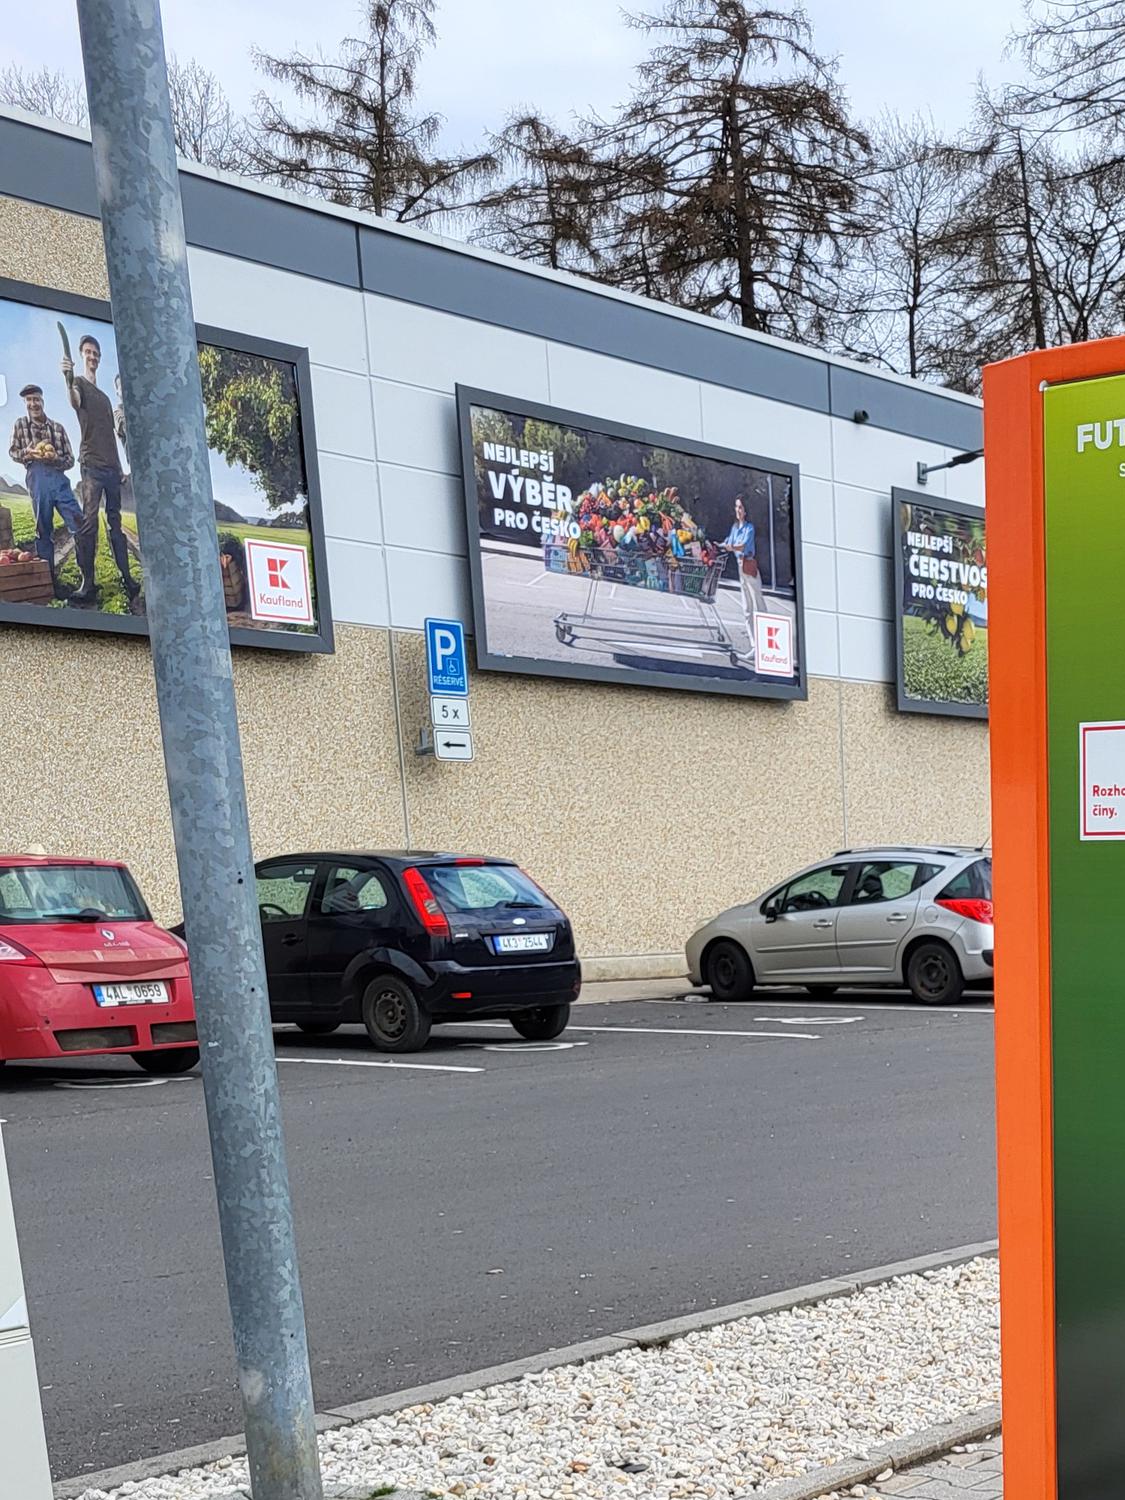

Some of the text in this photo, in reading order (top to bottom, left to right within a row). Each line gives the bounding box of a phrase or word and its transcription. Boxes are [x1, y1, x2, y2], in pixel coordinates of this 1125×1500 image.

[483, 441, 555, 474] NEJLEPŠÍ
[487, 468, 573, 514] VÝBĚR
[494, 508, 581, 539] PRO ČESKO
[907, 531, 953, 554] NEJLEPŠÍ
[909, 548, 987, 589] ČERSTVOS
[259, 593, 304, 608] Kaufland
[911, 582, 969, 605] PRO ČESKO
[434, 628, 457, 671] P
[442, 705, 449, 719] 5
[1092, 804, 1118, 819] činy.
[106, 983, 162, 1000] 4AL 0659
